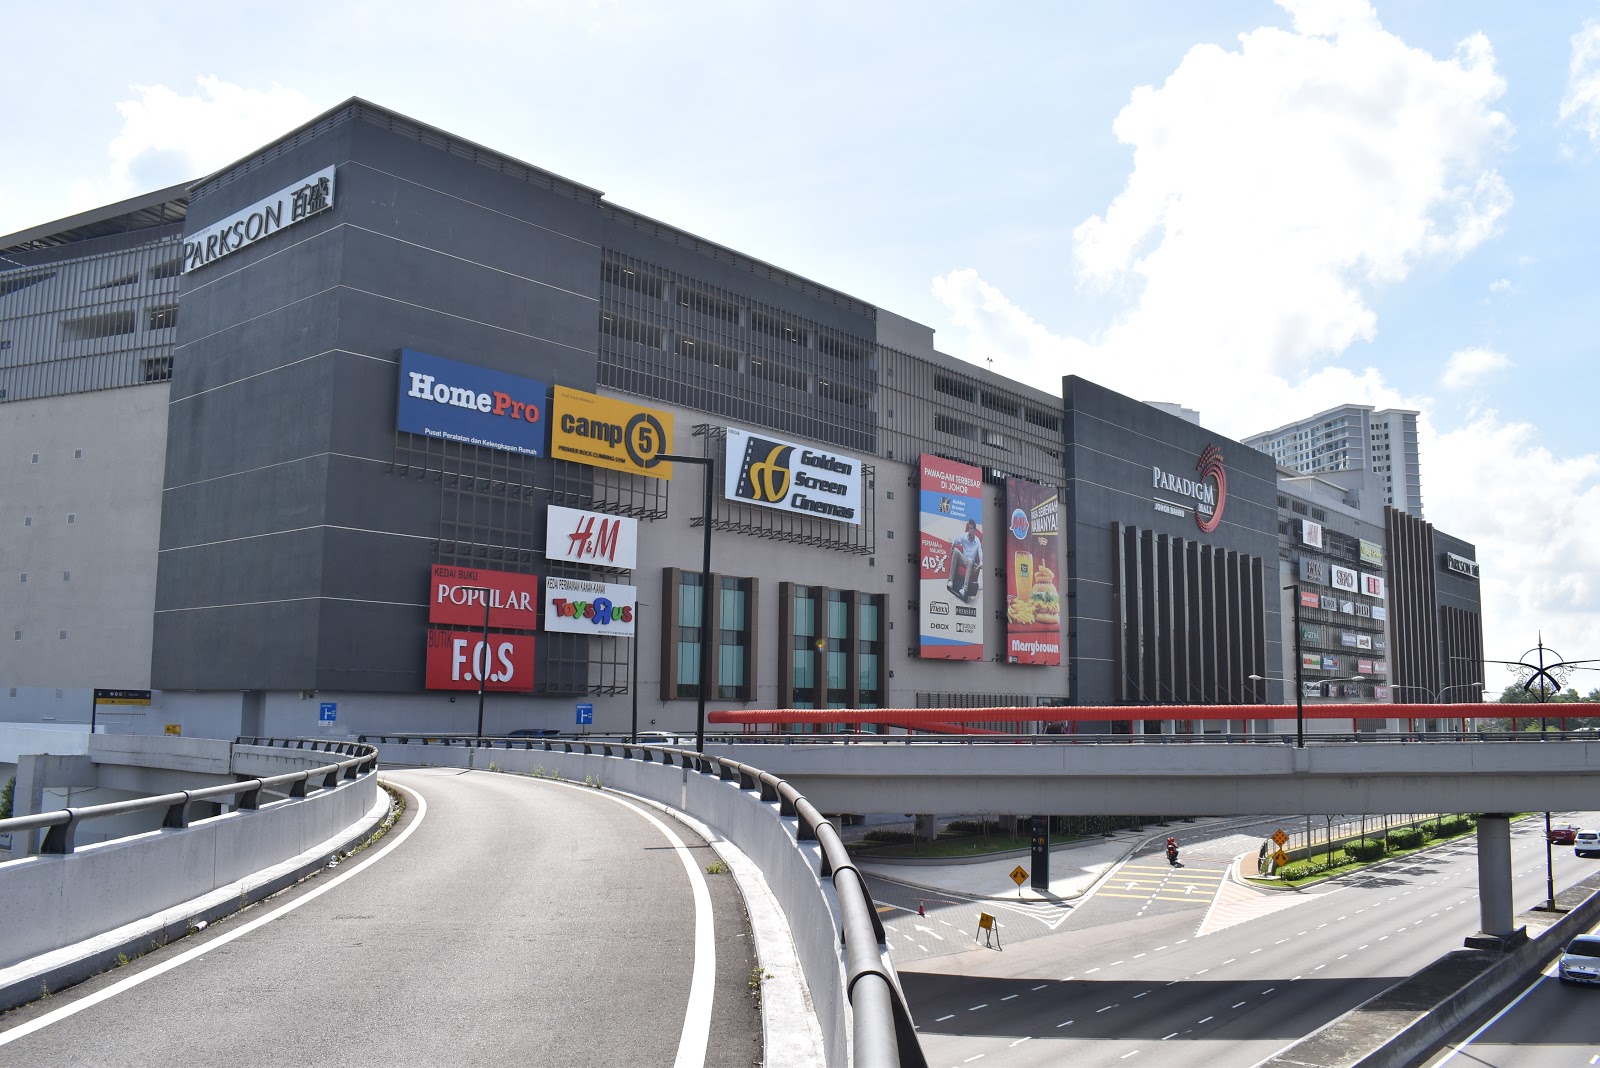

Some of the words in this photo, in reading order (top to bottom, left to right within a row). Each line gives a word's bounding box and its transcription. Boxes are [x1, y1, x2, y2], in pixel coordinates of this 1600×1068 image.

[290, 176, 330, 222] 百盛
[183, 200, 282, 272] PARKSON
[408, 371, 540, 424] HomePro
[424, 428, 442, 437] Pusat
[442, 431, 470, 443] Peralatan
[482, 439, 518, 452] Kelengkapan
[518, 446, 537, 455] Rumah
[561, 413, 623, 448] camp
[638, 426, 652, 453] 5
[558, 445, 579, 455] PREMIER
[579, 449, 593, 457] ROCK
[593, 452, 615, 462] CLIMBING
[615, 456, 626, 464] GYM
[800, 450, 853, 475] Golden
[794, 471, 848, 496] Screen
[924, 467, 955, 482] PAWAGAM
[955, 474, 981, 489] TERBESAR
[940, 480, 948, 489] DI
[948, 483, 968, 494] JOHOR
[1152, 465, 1215, 506] PARADIGM
[790, 493, 855, 519] Cinemas
[1154, 503, 1170, 514] JOHOR
[1197, 502, 1214, 515] MALL
[567, 515, 621, 562] H&M
[434, 567, 457, 579] KEDAI
[458, 569, 478, 581] BUKU
[922, 554, 948, 574] 4DX
[547, 578, 558, 589] KEDAI
[437, 584, 533, 612] POPULAR
[429, 630, 453, 649] BUTIK
[1012, 639, 1059, 656] Marrybrown
